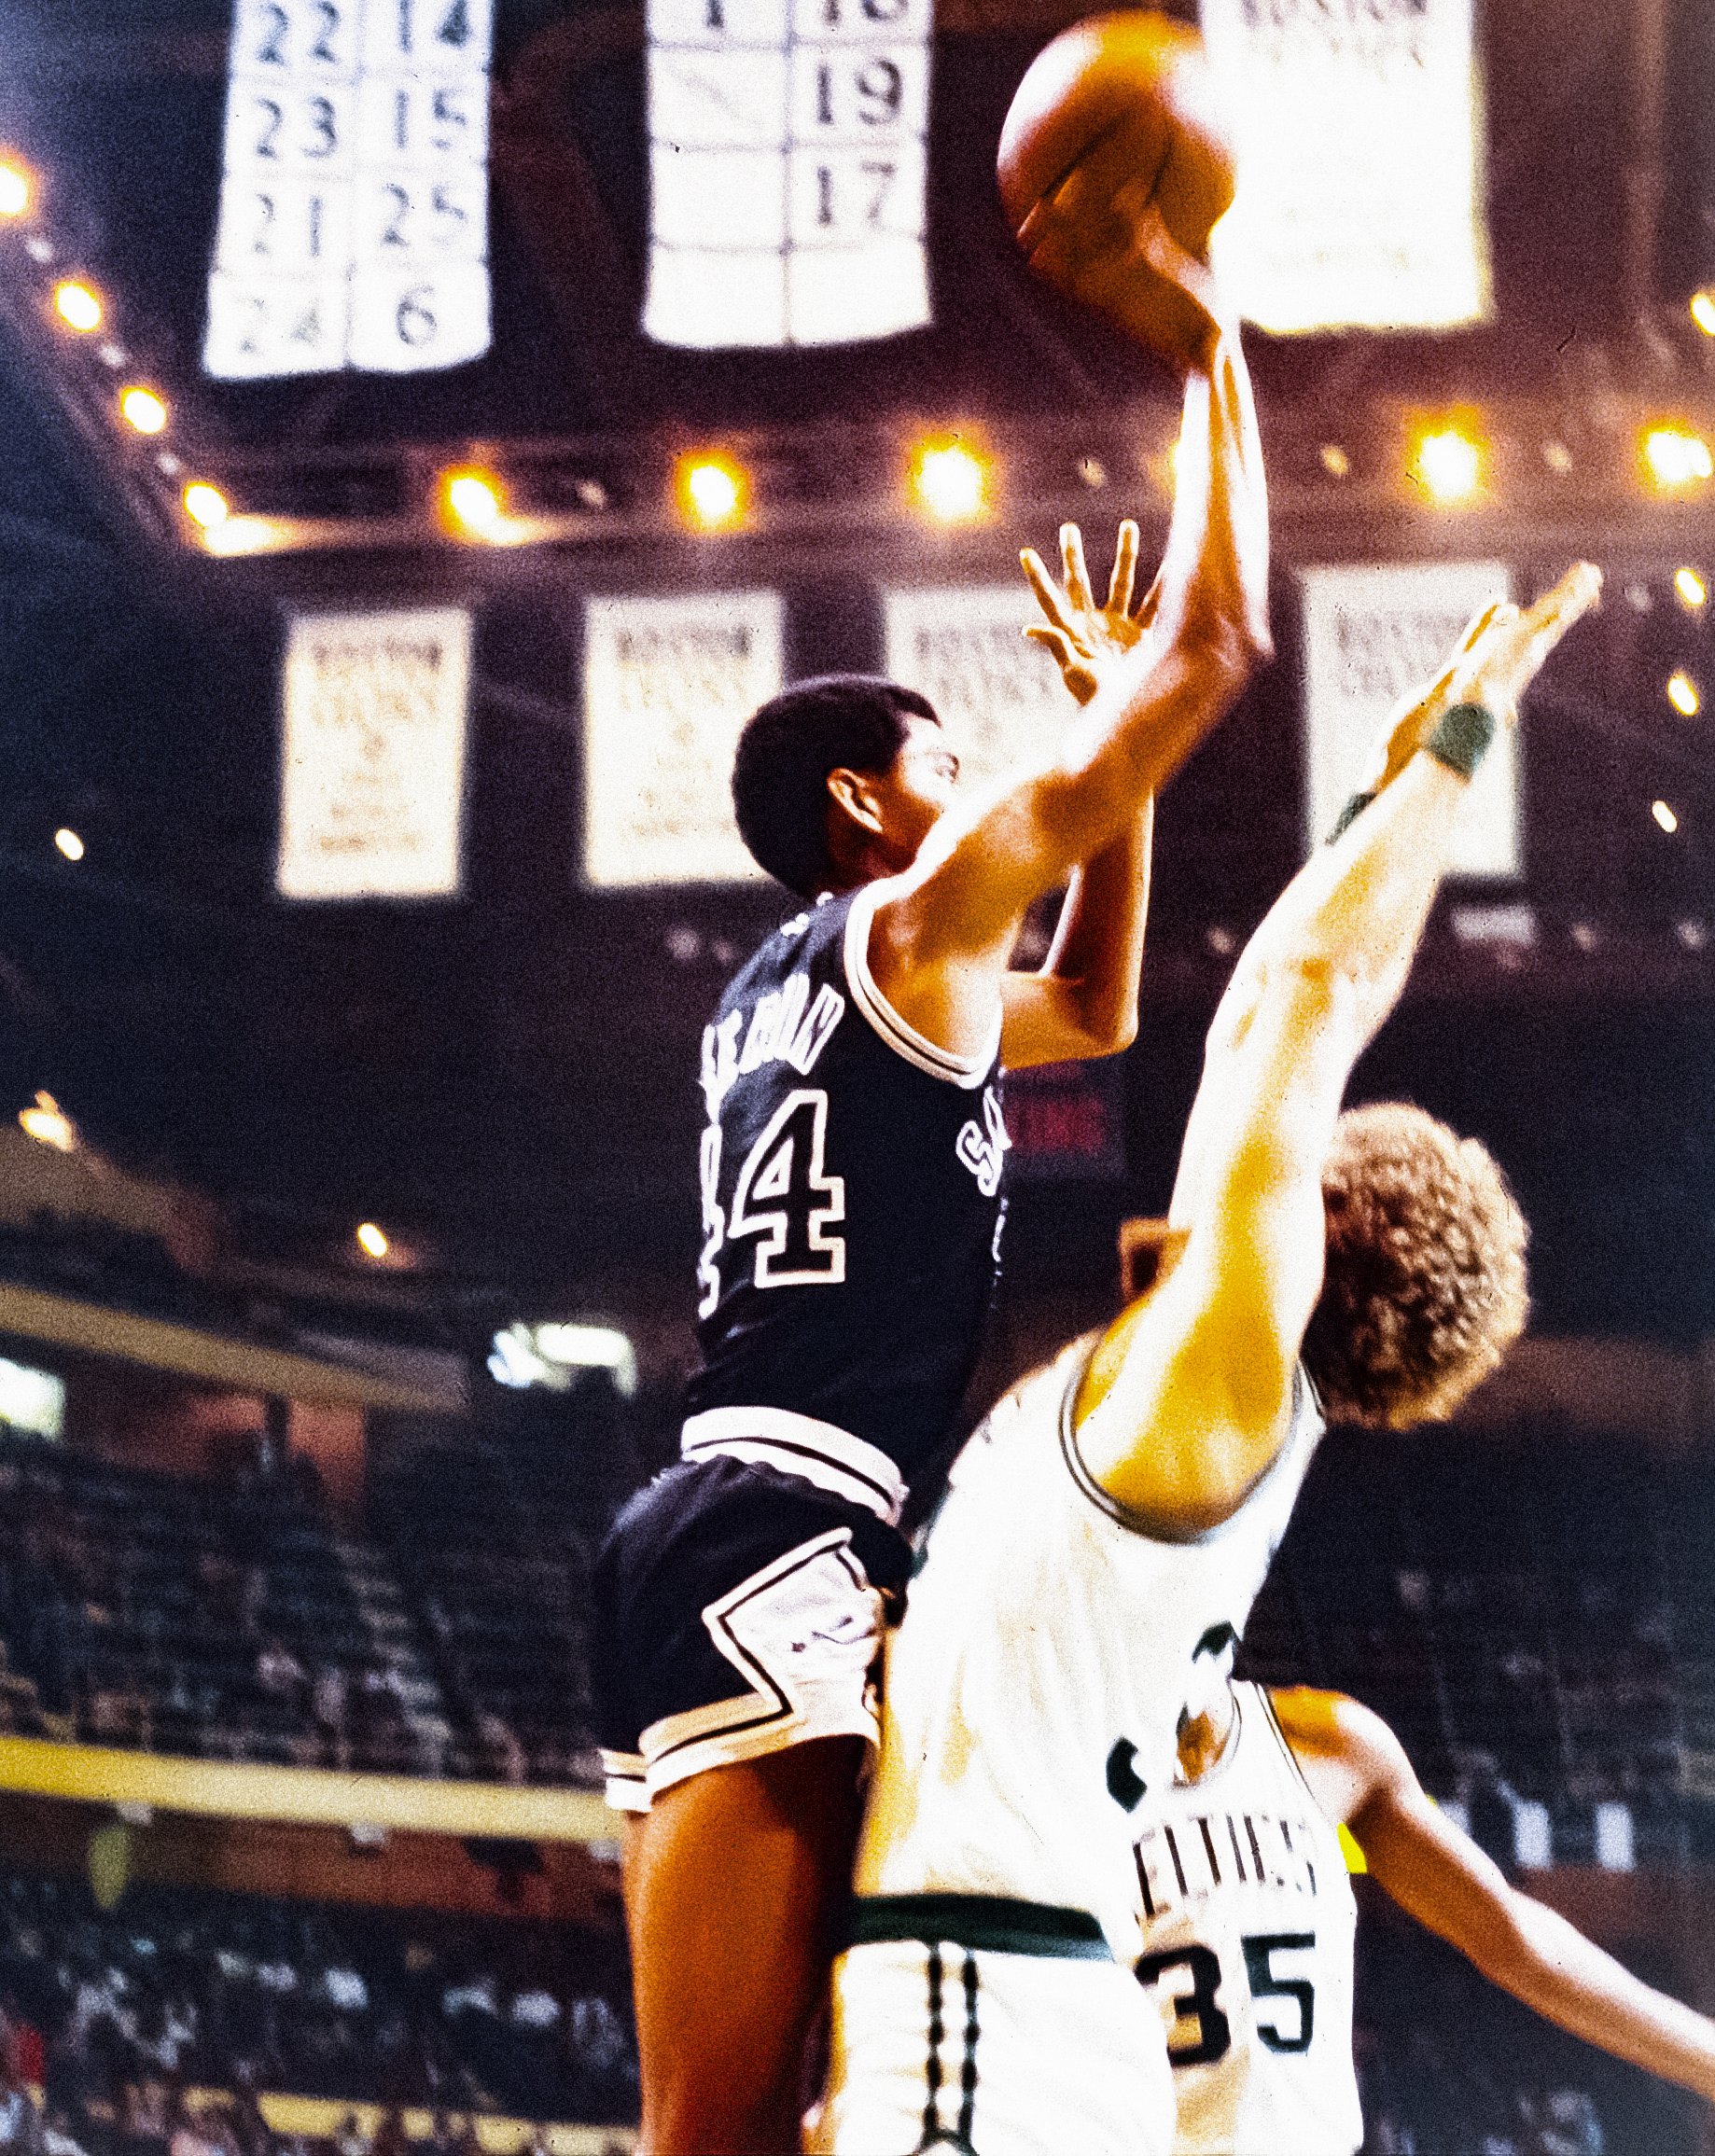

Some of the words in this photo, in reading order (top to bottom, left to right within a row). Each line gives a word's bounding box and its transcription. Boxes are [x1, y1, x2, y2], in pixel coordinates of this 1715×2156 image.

[255, 0, 339, 66] 22
[398, 0, 473, 53] 14
[255, 95, 338, 160] 23
[396, 88, 467, 151] 15
[817, 57, 903, 126] 19
[254, 192, 322, 258] 21
[380, 182, 468, 249] 25
[816, 161, 897, 229] 17
[396, 285, 439, 347] 6
[1134, 1930, 1317, 2067] 35
